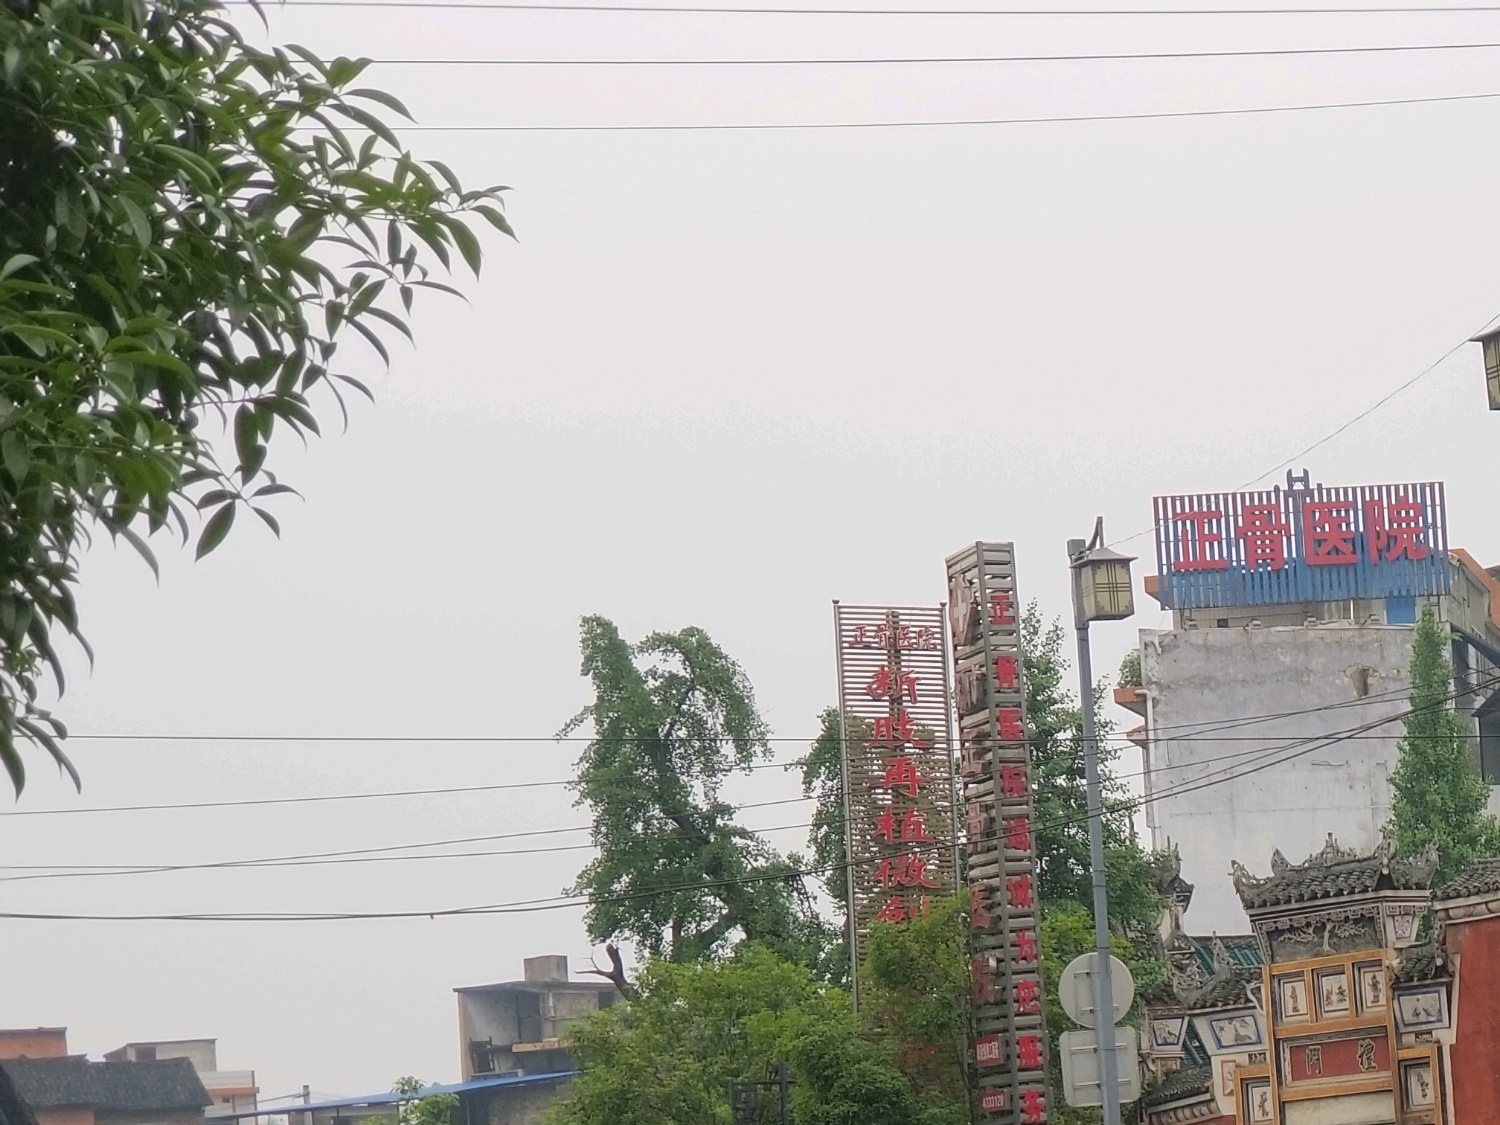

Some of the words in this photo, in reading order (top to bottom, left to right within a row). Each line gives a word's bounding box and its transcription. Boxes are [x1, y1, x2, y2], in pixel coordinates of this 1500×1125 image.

[1173, 496, 1428, 571] 正骨医院
[853, 624, 938, 650] 正骨医院
